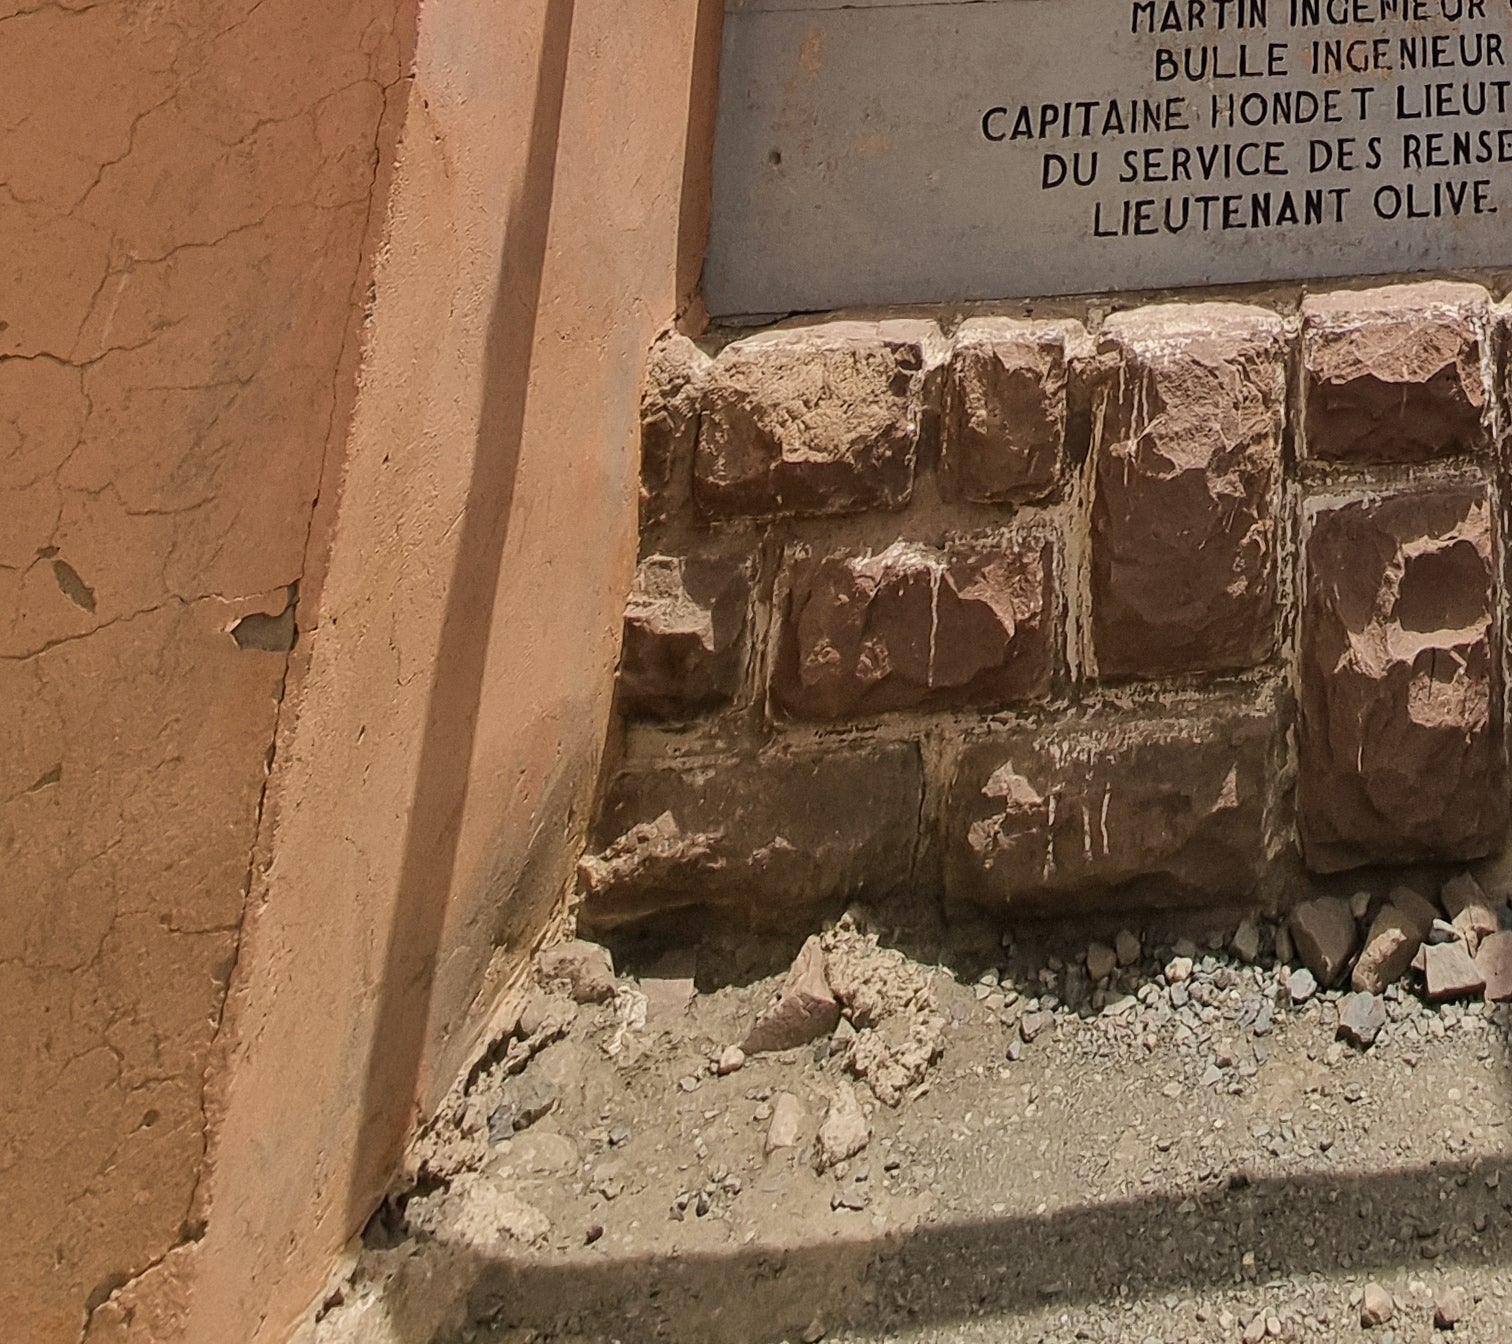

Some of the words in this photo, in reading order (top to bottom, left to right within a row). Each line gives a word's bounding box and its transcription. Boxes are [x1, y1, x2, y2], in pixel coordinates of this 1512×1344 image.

[1156, 43, 1288, 81] BULLE
[1312, 34, 1504, 74] INGENIEUR
[982, 97, 1189, 141] CAPITAINE
[1212, 88, 1374, 128] HONDET
[1042, 152, 1097, 189] DU
[1120, 142, 1288, 182] SERVICE
[1310, 137, 1381, 173] DES
[1094, 188, 1351, 237] LIEUTENANT
[1373, 180, 1498, 220] OLIVE
